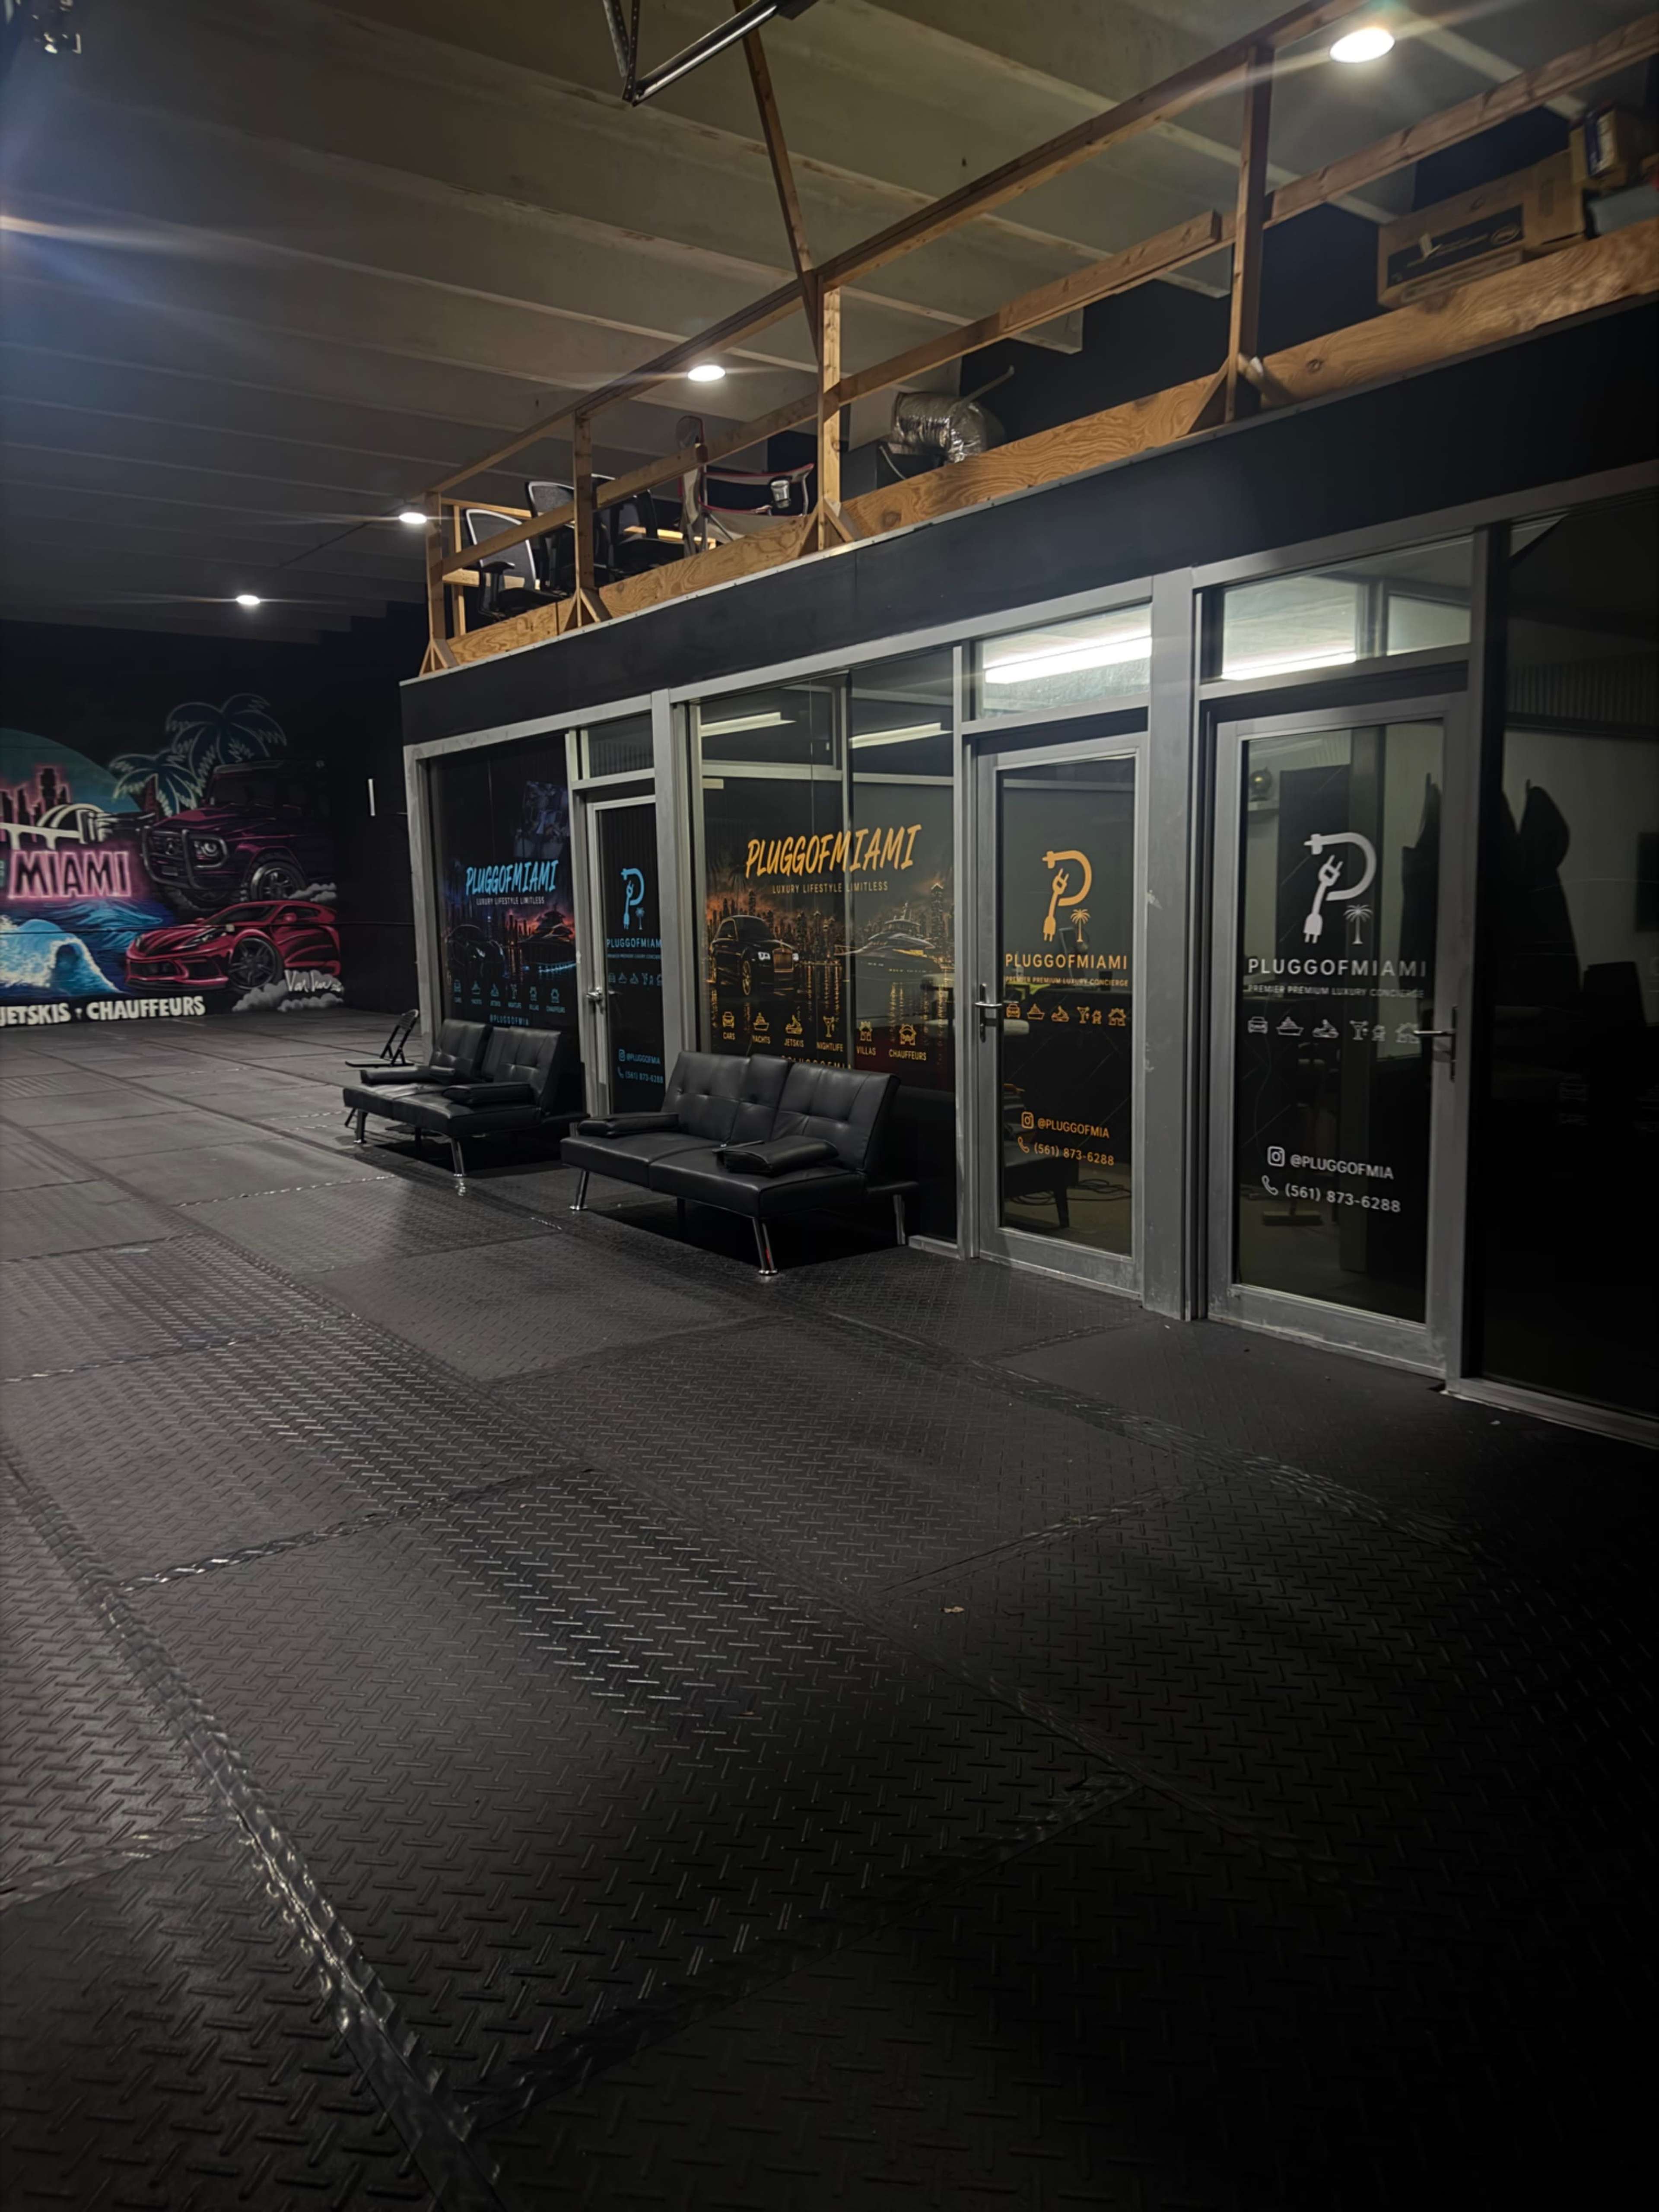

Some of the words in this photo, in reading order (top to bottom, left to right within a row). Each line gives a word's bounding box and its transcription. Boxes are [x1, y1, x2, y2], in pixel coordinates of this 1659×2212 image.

[745, 824, 922, 879] PLUGGOFMIAMI
[7, 850, 131, 899] MIAMI
[466, 859, 559, 896] PLUGGOFMIAMI
[772, 884, 799, 894] LUXURY
[803, 882, 842, 893] LIFESTYLE
[846, 881, 888, 892] LIMITLESS
[606, 938, 662, 948] PLUGGOFMIAM
[1005, 953, 1127, 969] PLUGGOFMIAMI
[1248, 958, 1426, 978] PLUGGOFMIAMI
[86, 995, 206, 1021] CHAUFFEURS
[816, 1041, 844, 1052] NIGHTLIFE
[856, 1046, 877, 1056] VILLAS
[888, 1049, 927, 1061] CHAUFFEURS
[1037, 1117, 1110, 1139] @PLUGGOFMIA
[1034, 1142, 1059, 1157] (561)
[1063, 1147, 1114, 1166] 873-6288
[1290, 1154, 1395, 1180] @PLUGGOFMIA
[1285, 1183, 1321, 1202] (561)
[1326, 1190, 1402, 1213] 873-6288
